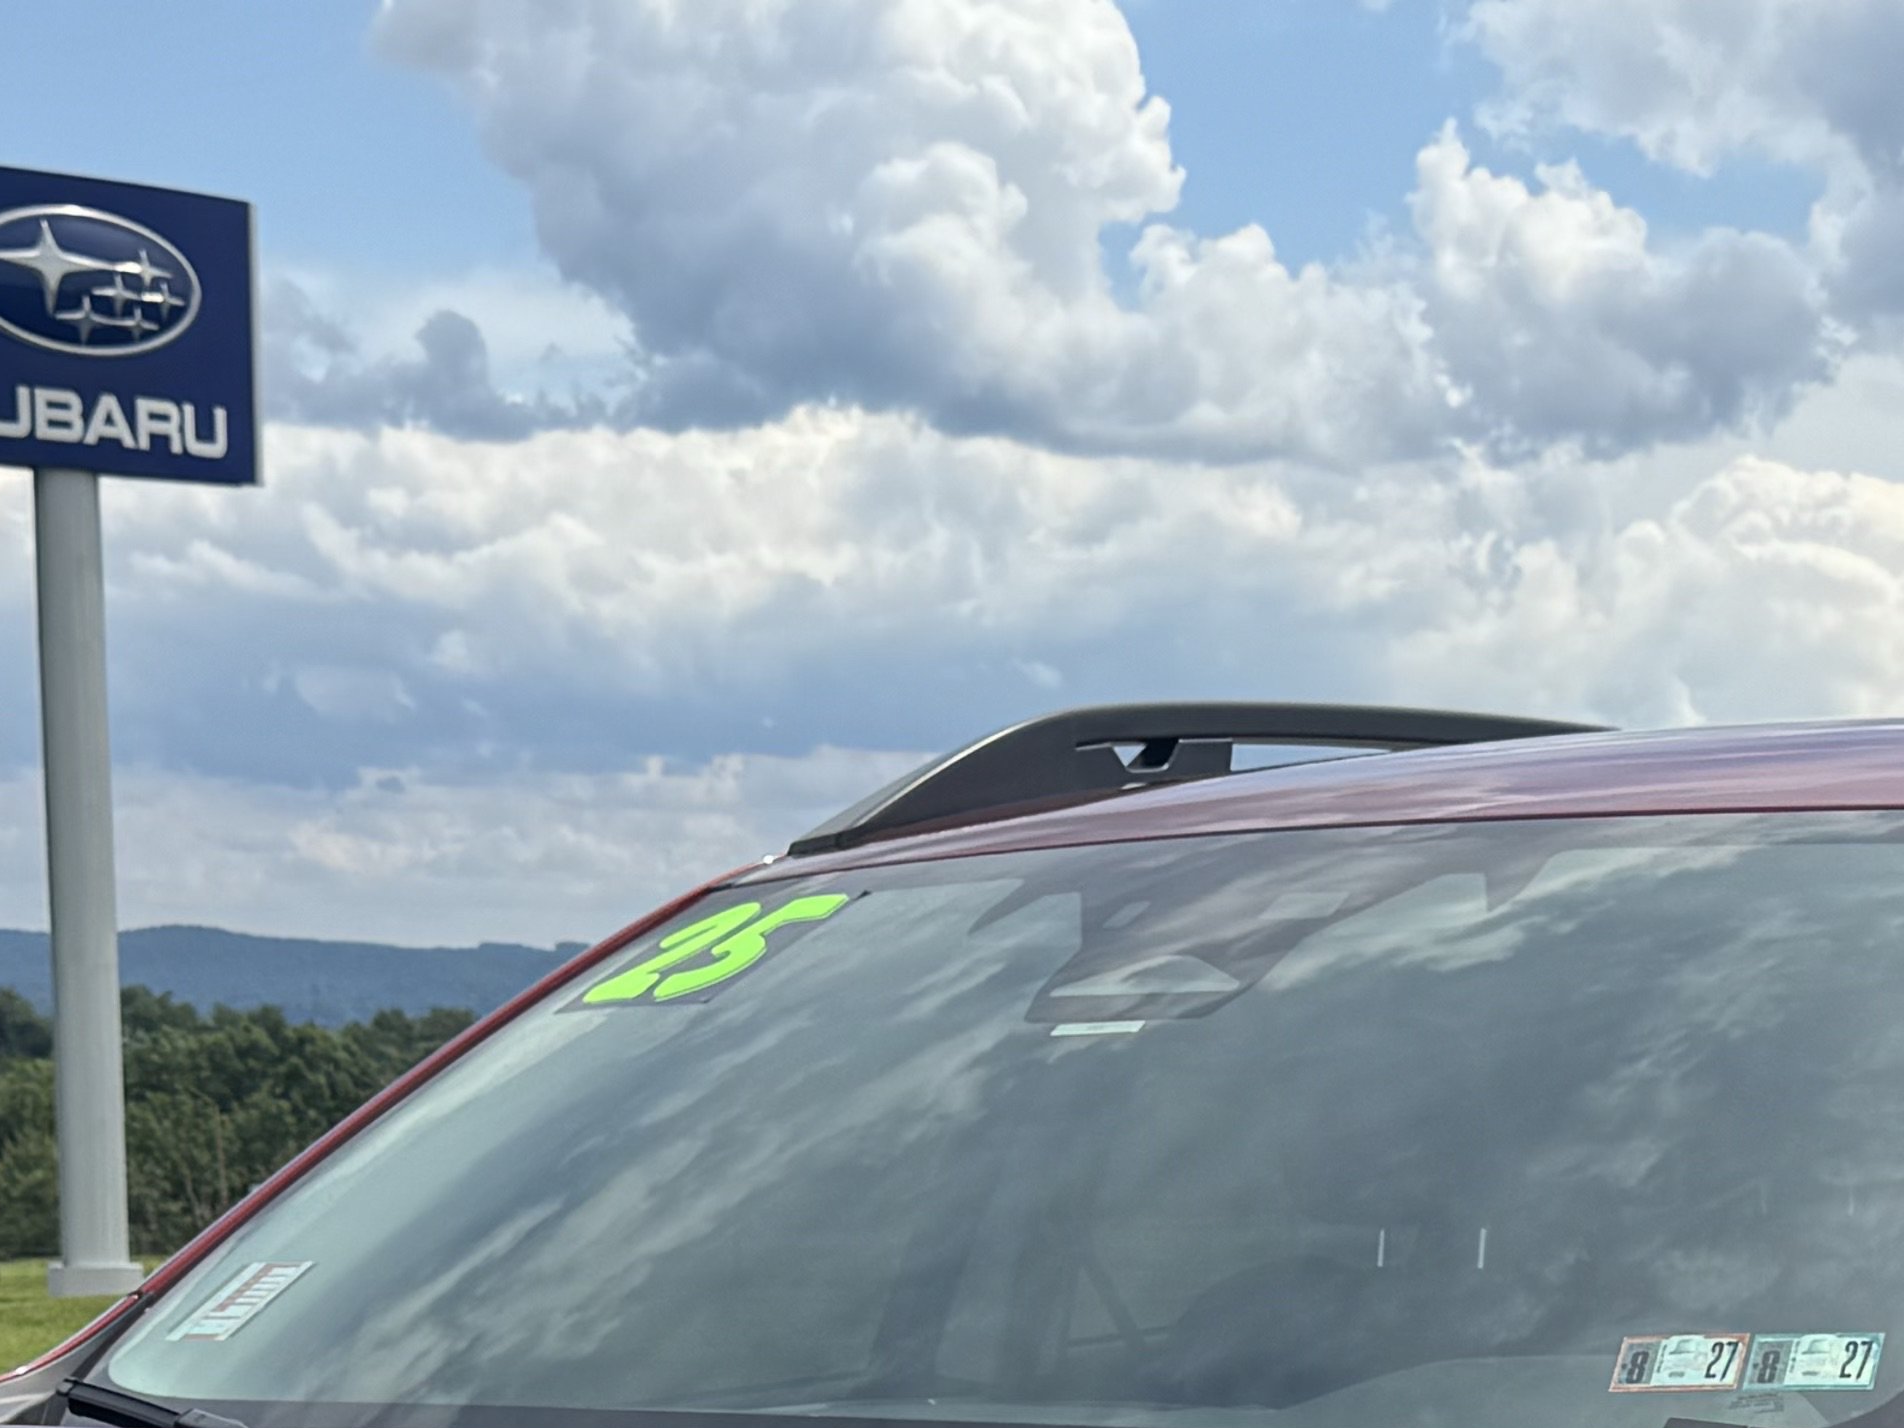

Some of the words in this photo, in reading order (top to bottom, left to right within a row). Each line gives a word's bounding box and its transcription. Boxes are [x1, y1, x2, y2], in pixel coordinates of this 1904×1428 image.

[582, 893, 849, 1003] 25
[1625, 1350, 1650, 1384] 8
[1704, 1340, 1740, 1382] 27
[1756, 1350, 1781, 1384] 8
[1838, 1340, 1874, 1381] 27
